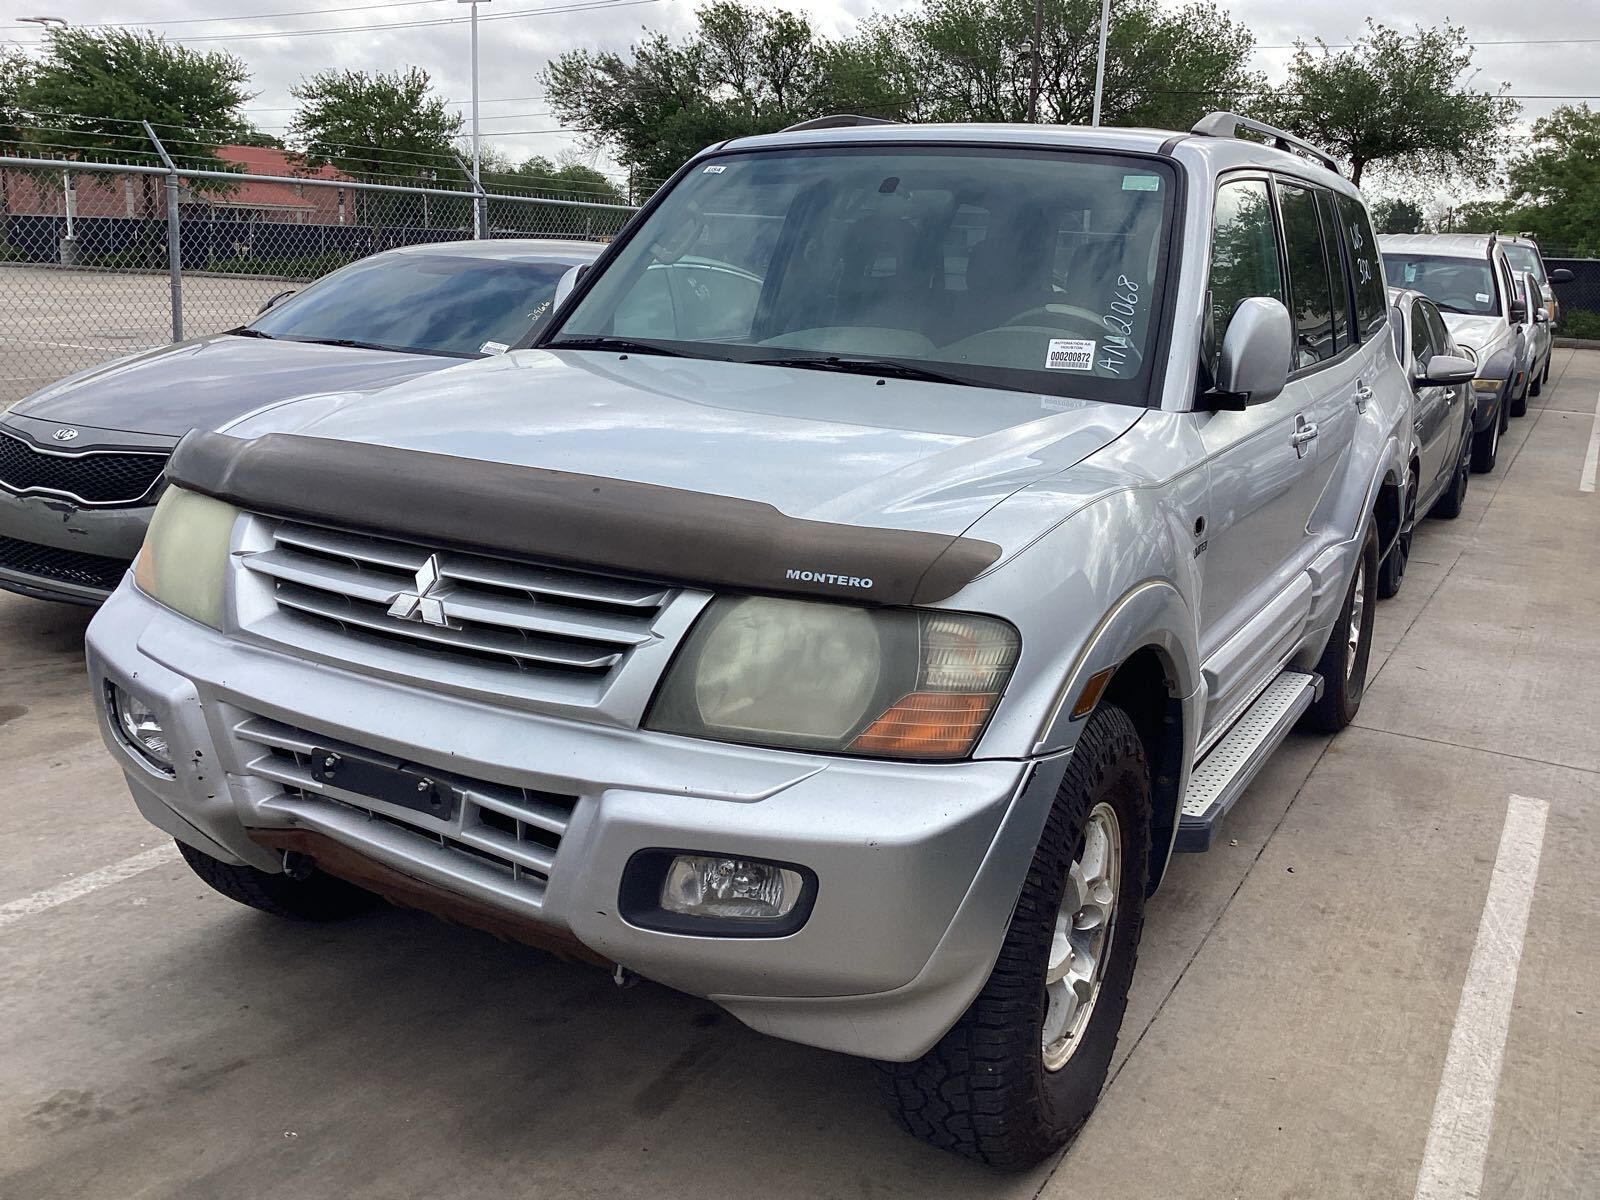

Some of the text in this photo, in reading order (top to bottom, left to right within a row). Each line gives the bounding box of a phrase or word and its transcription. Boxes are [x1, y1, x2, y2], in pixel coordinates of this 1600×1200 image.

[1050, 351, 1091, 363] 000200872
[54, 429, 77, 440] KIA
[785, 569, 873, 589] MONTERO
